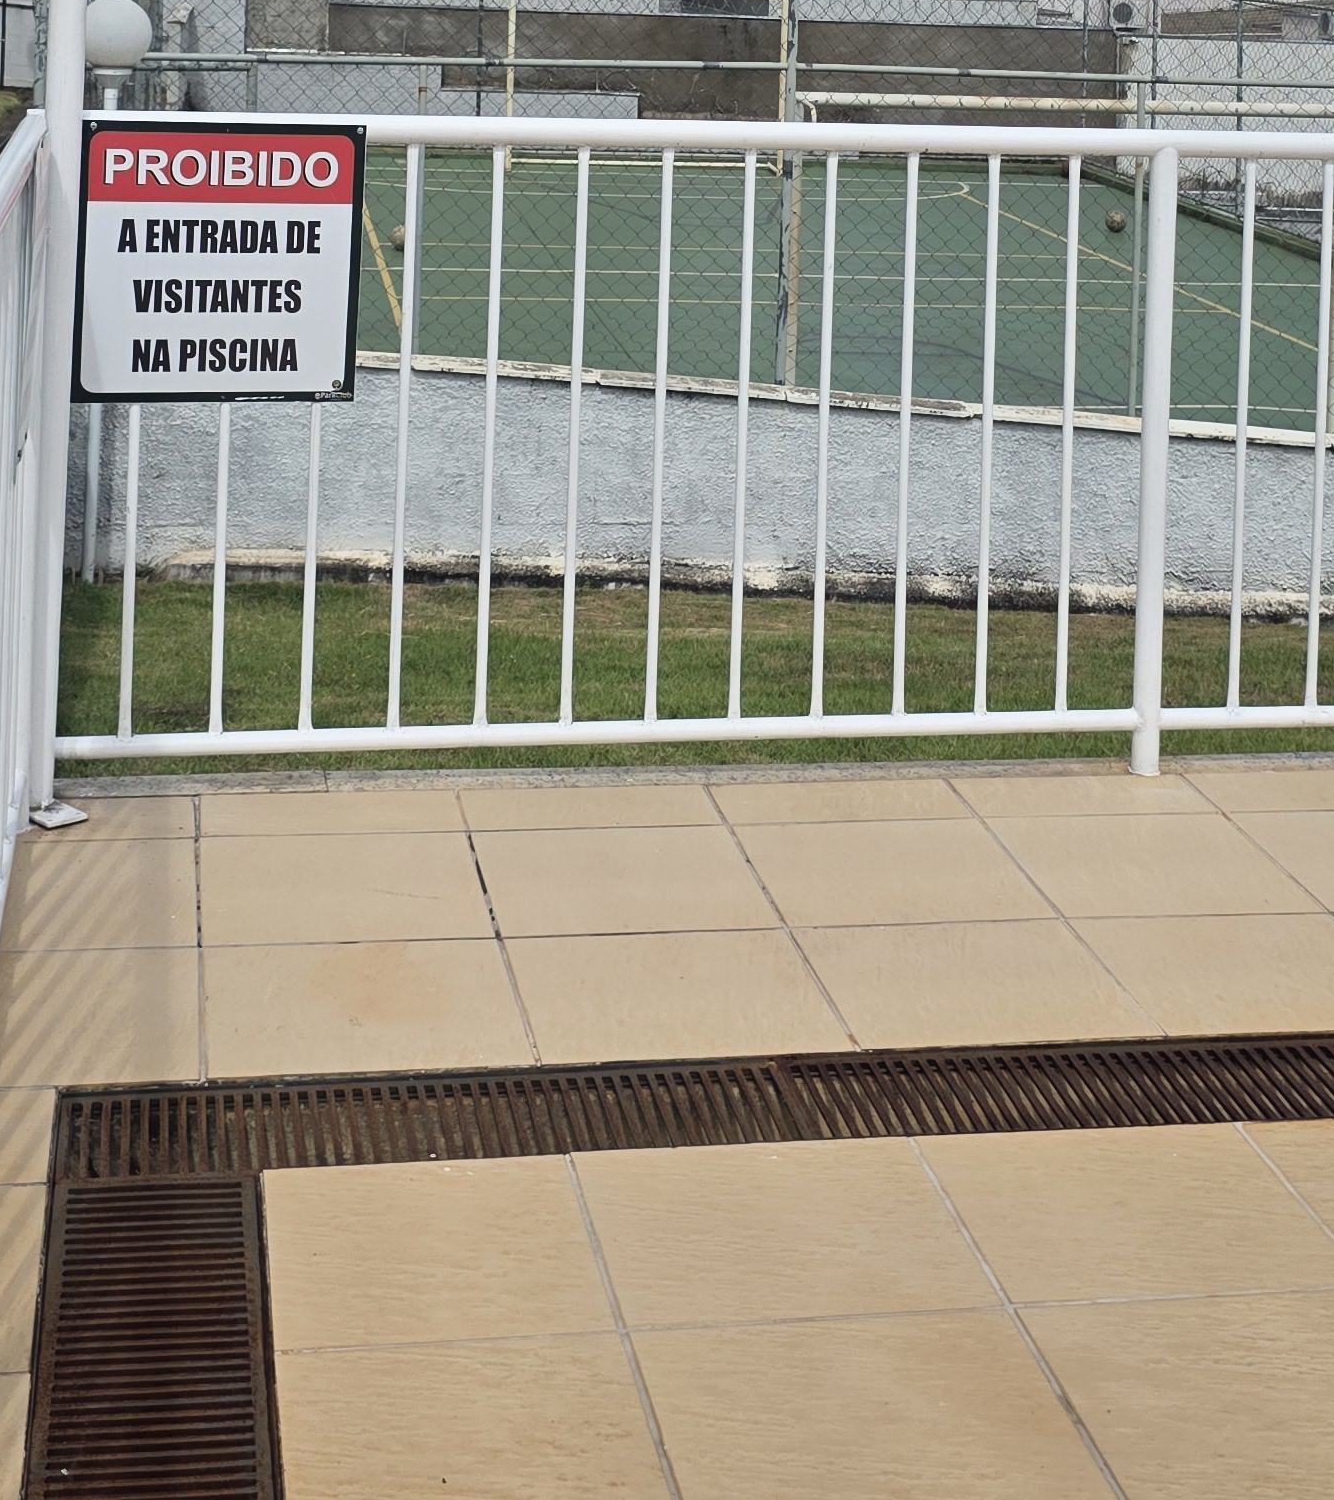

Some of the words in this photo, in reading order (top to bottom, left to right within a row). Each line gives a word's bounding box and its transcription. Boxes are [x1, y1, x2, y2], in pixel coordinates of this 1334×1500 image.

[103, 148, 339, 187] PROIBIDO
[117, 218, 138, 253] A
[145, 219, 279, 254] ENTRADA
[285, 220, 321, 254] DE
[132, 279, 302, 314] VISITANTES
[131, 338, 171, 373] NA
[178, 338, 298, 373] PISCINA
